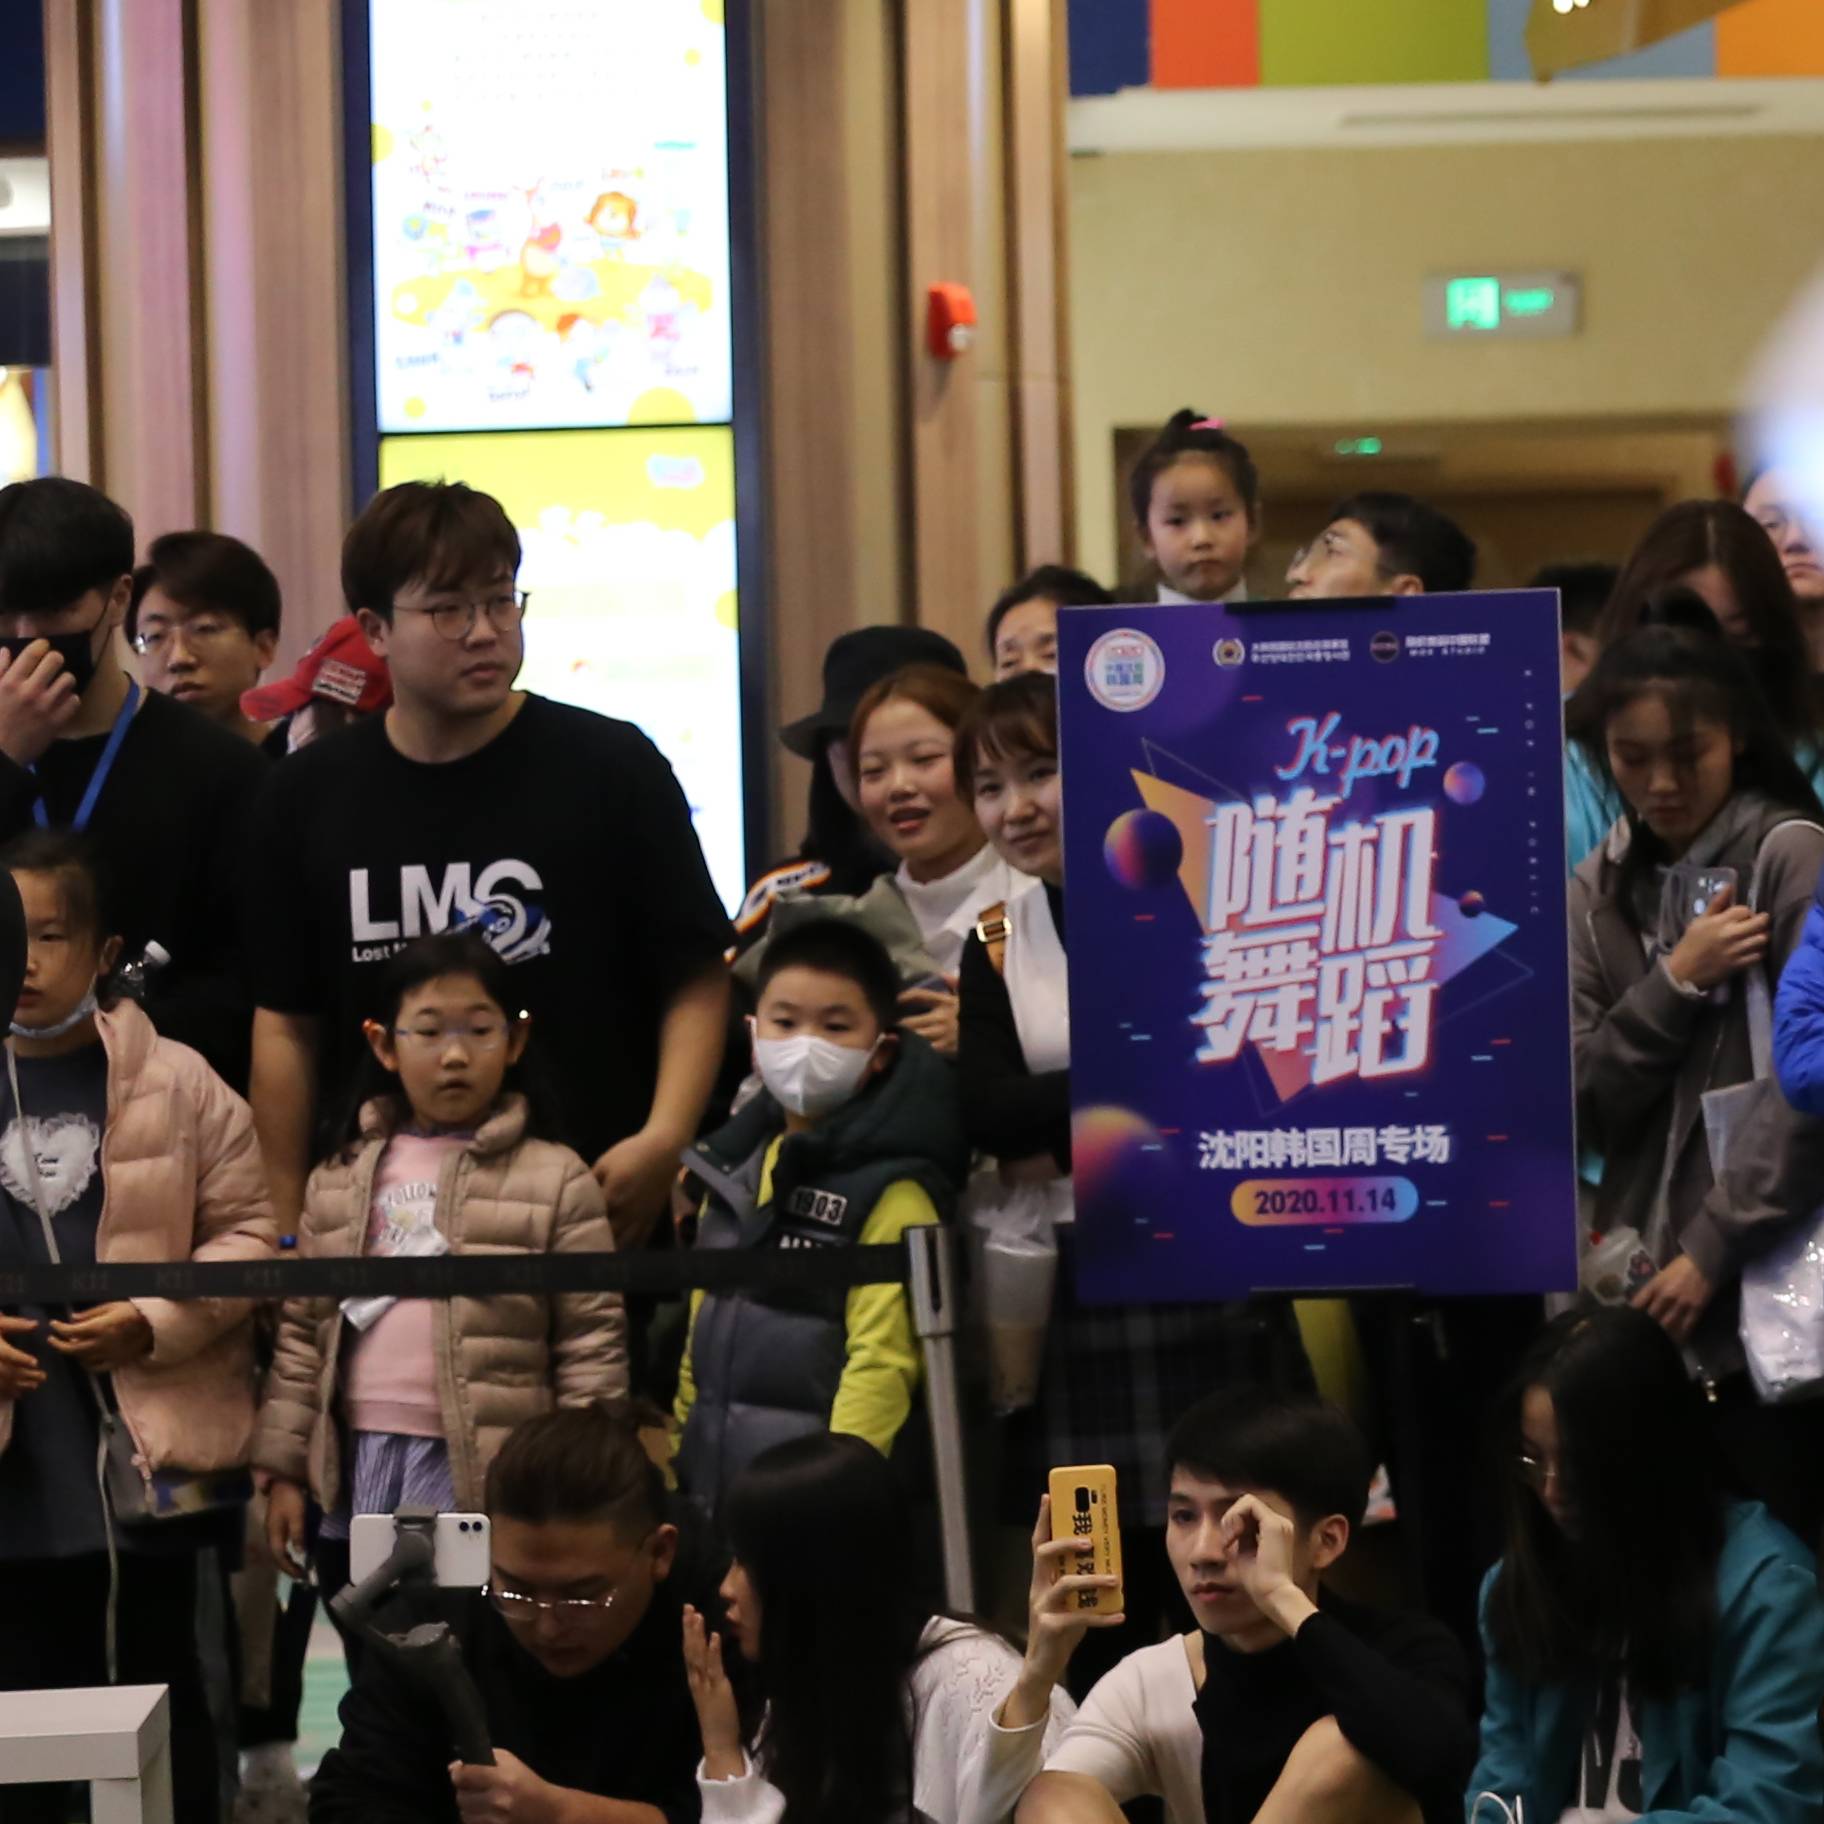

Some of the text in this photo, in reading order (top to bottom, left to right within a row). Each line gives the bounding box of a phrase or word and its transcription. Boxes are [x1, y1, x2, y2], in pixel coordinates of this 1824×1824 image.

[1278, 713, 1440, 797] K-pop
[1204, 785, 1444, 955] 随机
[1193, 925, 1442, 1086] 舞蹈
[1198, 1127, 1450, 1169] 沈阳韩国周专场
[1254, 1185, 1396, 1217] 2020.11.14
